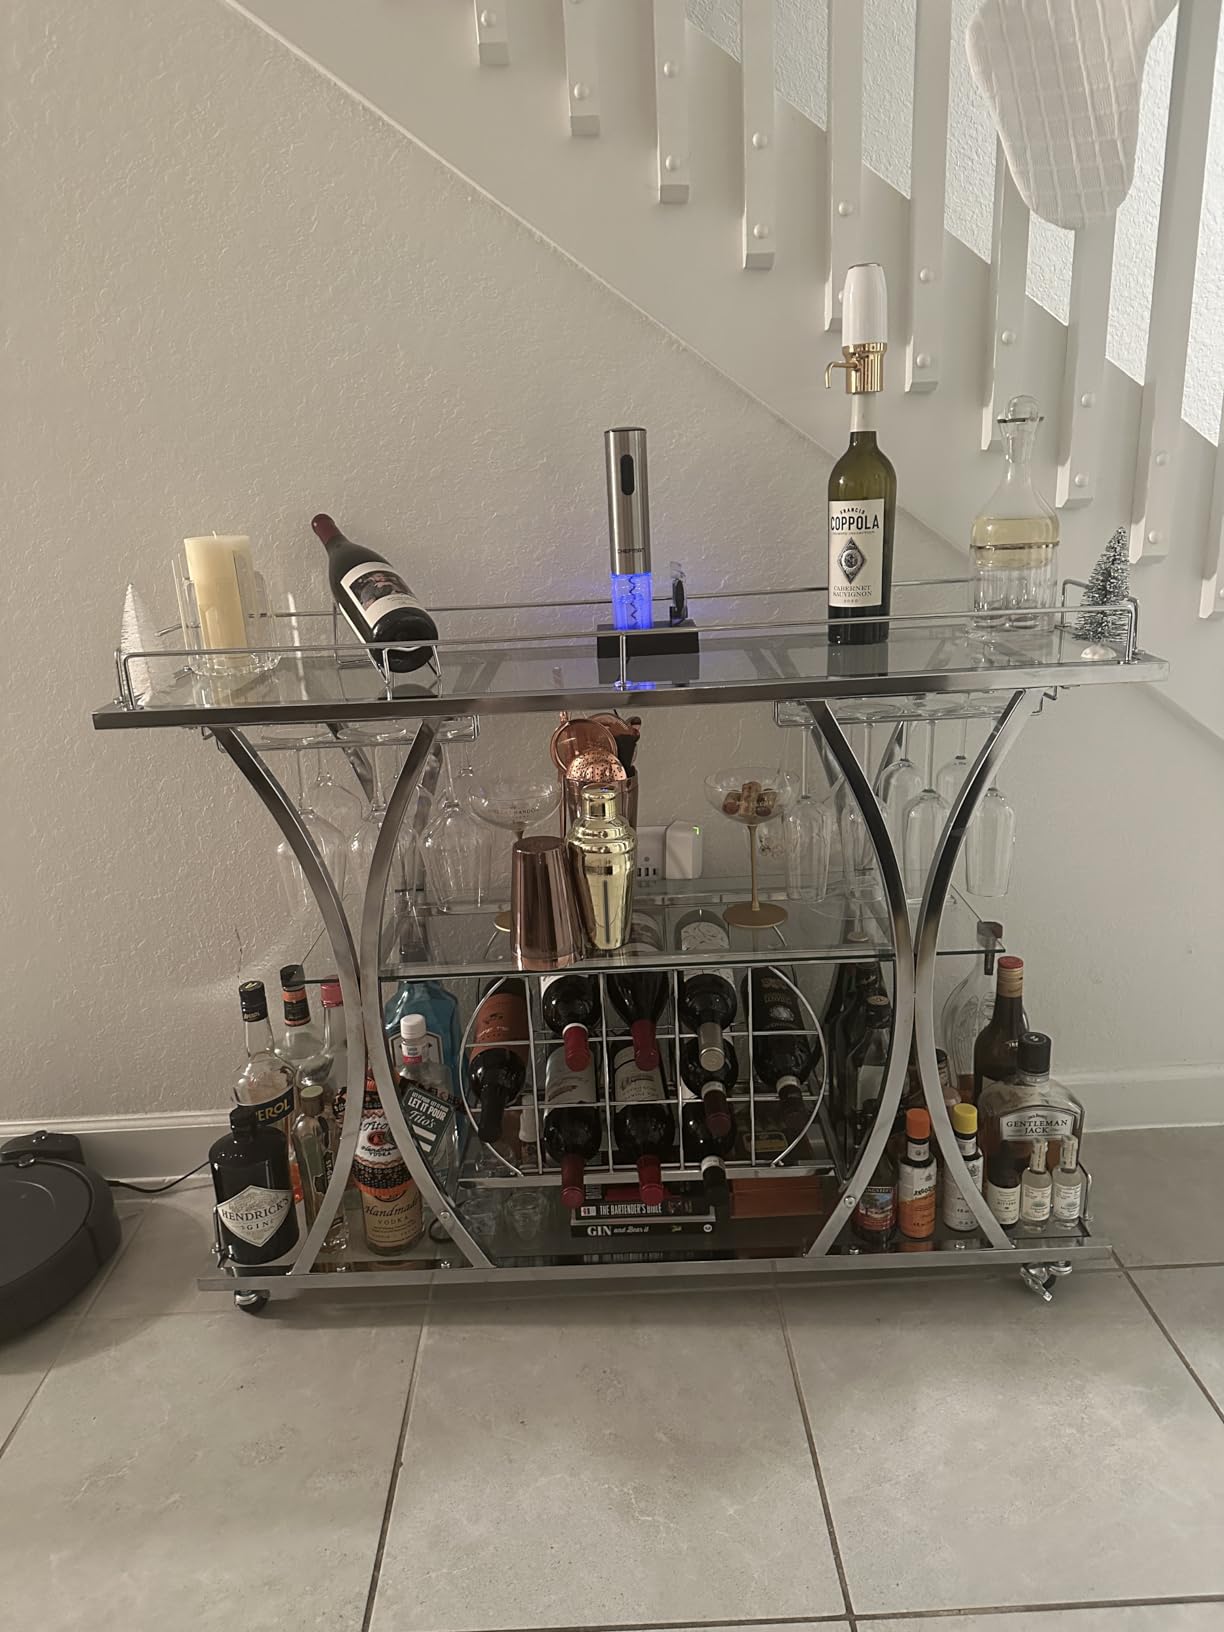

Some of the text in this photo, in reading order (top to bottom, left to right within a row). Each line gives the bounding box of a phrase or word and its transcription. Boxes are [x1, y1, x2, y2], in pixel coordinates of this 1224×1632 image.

[839, 507, 866, 515] FRANCIS
[830, 514, 880, 531] COPPOLA
[832, 590, 873, 598] SAUVIGNON
[833, 584, 872, 592] CABERNET
[407, 1096, 447, 1121] LET IT POUR
[409, 1110, 436, 1128] Tito's
[1006, 1119, 1068, 1128] GENTLEMAN
[600, 1205, 610, 1216] THE
[610, 1203, 646, 1215] BARTENDER'S
[246, 1219, 270, 1231] GIN
[587, 1225, 612, 1237] GIN
